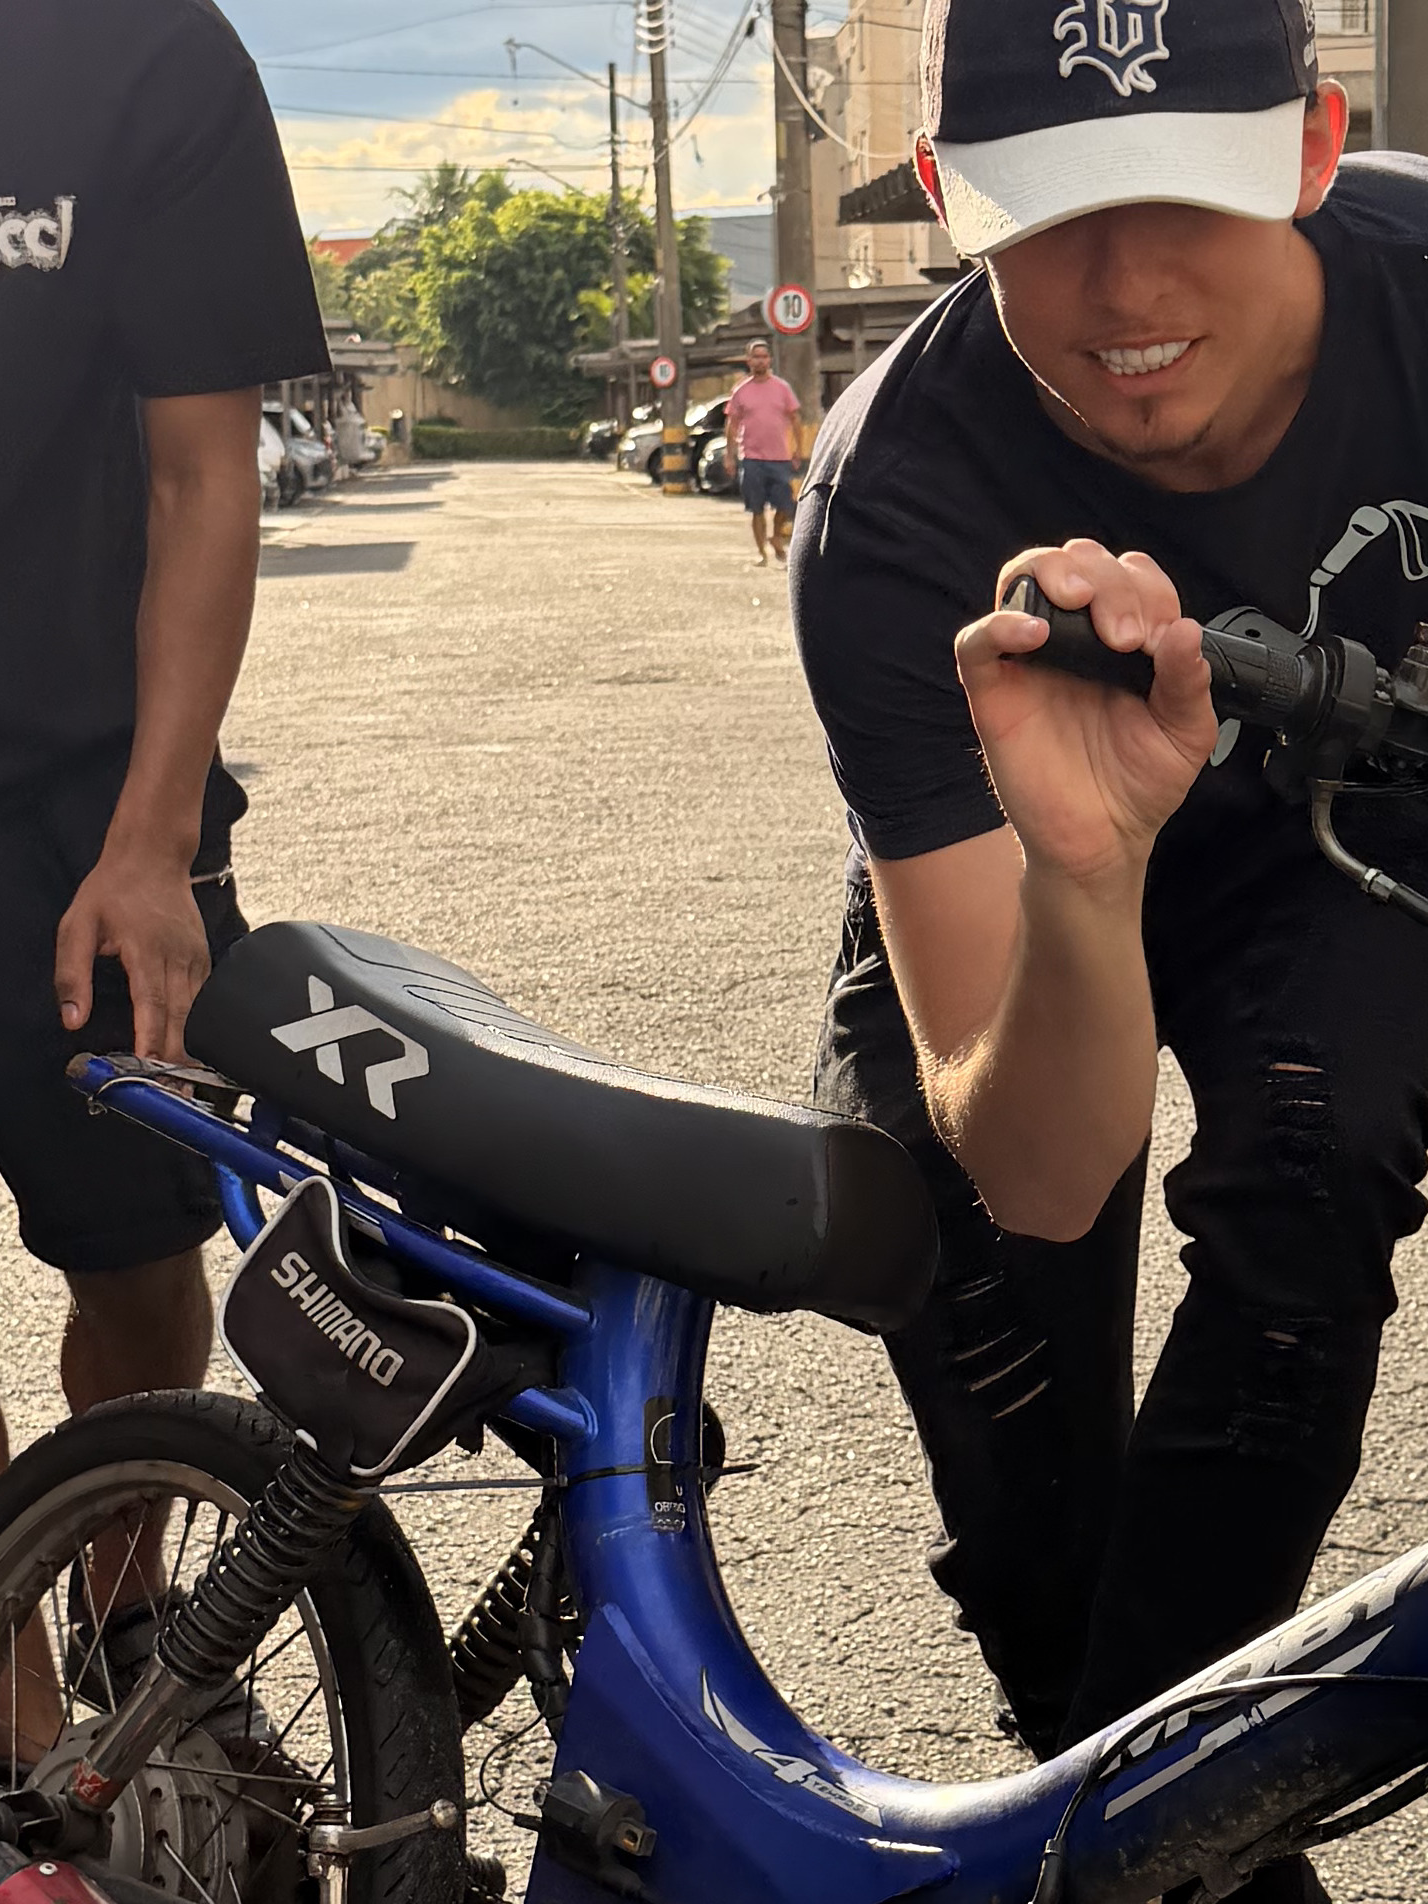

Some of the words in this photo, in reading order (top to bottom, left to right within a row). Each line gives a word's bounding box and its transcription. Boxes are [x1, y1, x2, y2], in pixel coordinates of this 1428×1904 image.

[782, 294, 803, 319] 10
[271, 1251, 405, 1388] SHIMANO
[753, 1750, 819, 1784] 4
